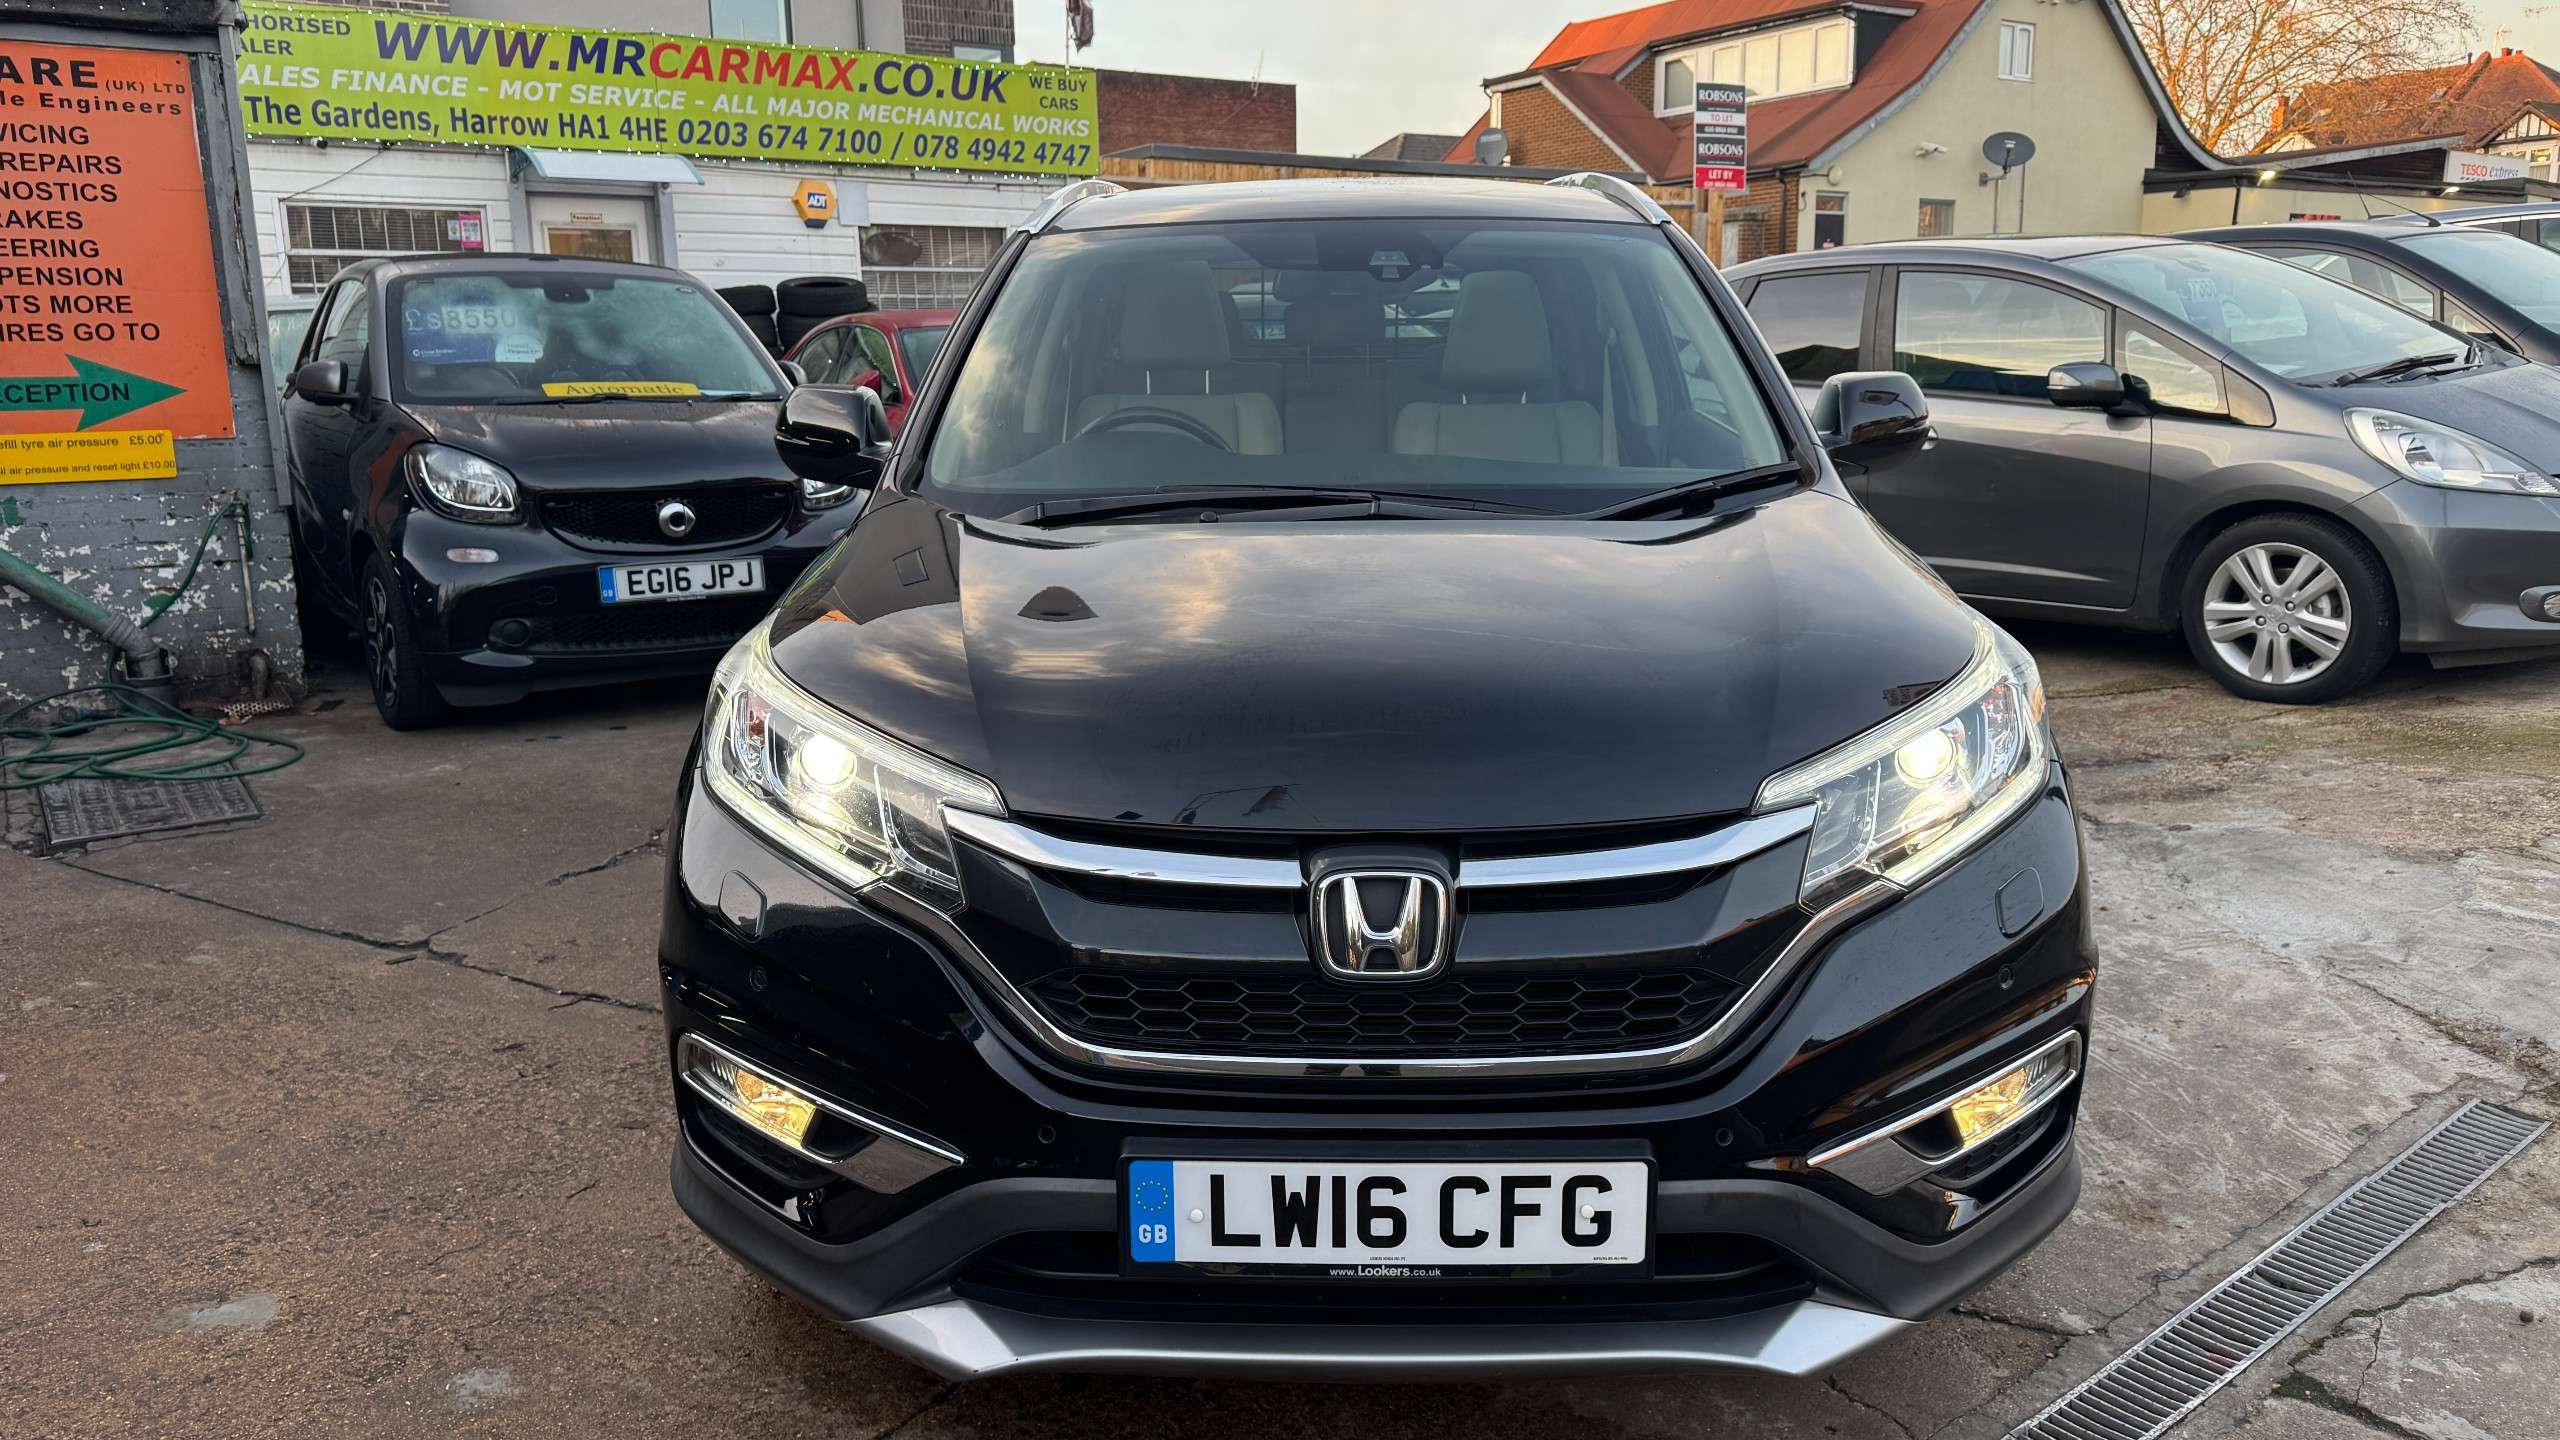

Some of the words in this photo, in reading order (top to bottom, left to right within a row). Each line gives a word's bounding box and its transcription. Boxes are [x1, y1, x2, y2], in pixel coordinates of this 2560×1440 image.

[374, 20, 1011, 103] WWW.MRCARMAX.CO.UK
[105, 79, 145, 94] (UK)
[154, 83, 186, 94] LTD
[1029, 75, 1054, 90] WE
[1057, 77, 1088, 92] BUY
[39, 93, 182, 115] Engineers
[240, 63, 320, 89] ALES
[331, 68, 468, 97] FINANCE
[500, 81, 562, 102] MOT
[570, 84, 686, 110] SERVICE
[712, 93, 758, 115] ALL
[767, 98, 849, 121] MAJOR
[858, 104, 1005, 131] MECHANICAL
[1013, 114, 1090, 137] WORKS
[1039, 95, 1079, 110] CARS
[1698, 89, 1743, 103] ROBSONS
[245, 96, 301, 125] The
[311, 99, 440, 137] Gardens,
[450, 107, 549, 137] Harrow
[559, 113, 608, 139] HA1
[619, 115, 667, 143] 4HE
[678, 118, 748, 148] 0203
[758, 122, 807, 150] 674
[818, 126, 882, 155] 7100
[914, 134, 959, 159] 078
[967, 139, 1026, 163] 4942
[1034, 143, 1090, 167] 4747
[1698, 143, 1743, 156] ROBSONS
[0, 152, 122, 175] REPAIRS
[2460, 163, 2488, 177] TESCO
[1709, 169, 1721, 180] LET
[808, 193, 825, 207] ADT
[0, 210, 83, 229] AKES
[0, 267, 123, 286] PENSION
[0, 295, 40, 313] TS
[50, 295, 133, 314] MORE
[73, 323, 115, 341] GO
[123, 323, 160, 341] TO
[0, 382, 130, 404] CEPTION
[566, 384, 683, 395] Automatic
[21, 438, 44, 452] tyre
[47, 437, 63, 448] air
[66, 436, 119, 450] pressure
[129, 433, 163, 446] £5.00
[10, 464, 21, 475] air
[25, 463, 69, 476] pressure
[71, 464, 90, 473] and
[93, 463, 117, 472] reset
[120, 461, 141, 471] light
[143, 459, 175, 470] £10.00
[627, 567, 692, 597] EG16
[702, 561, 754, 591] JPJ
[1209, 1174, 1408, 1248] LW16
[1439, 1174, 1613, 1249] CFG
[1138, 1224, 1168, 1244] GB
[1330, 1265, 1441, 1276] www.Lookers.co.uk
